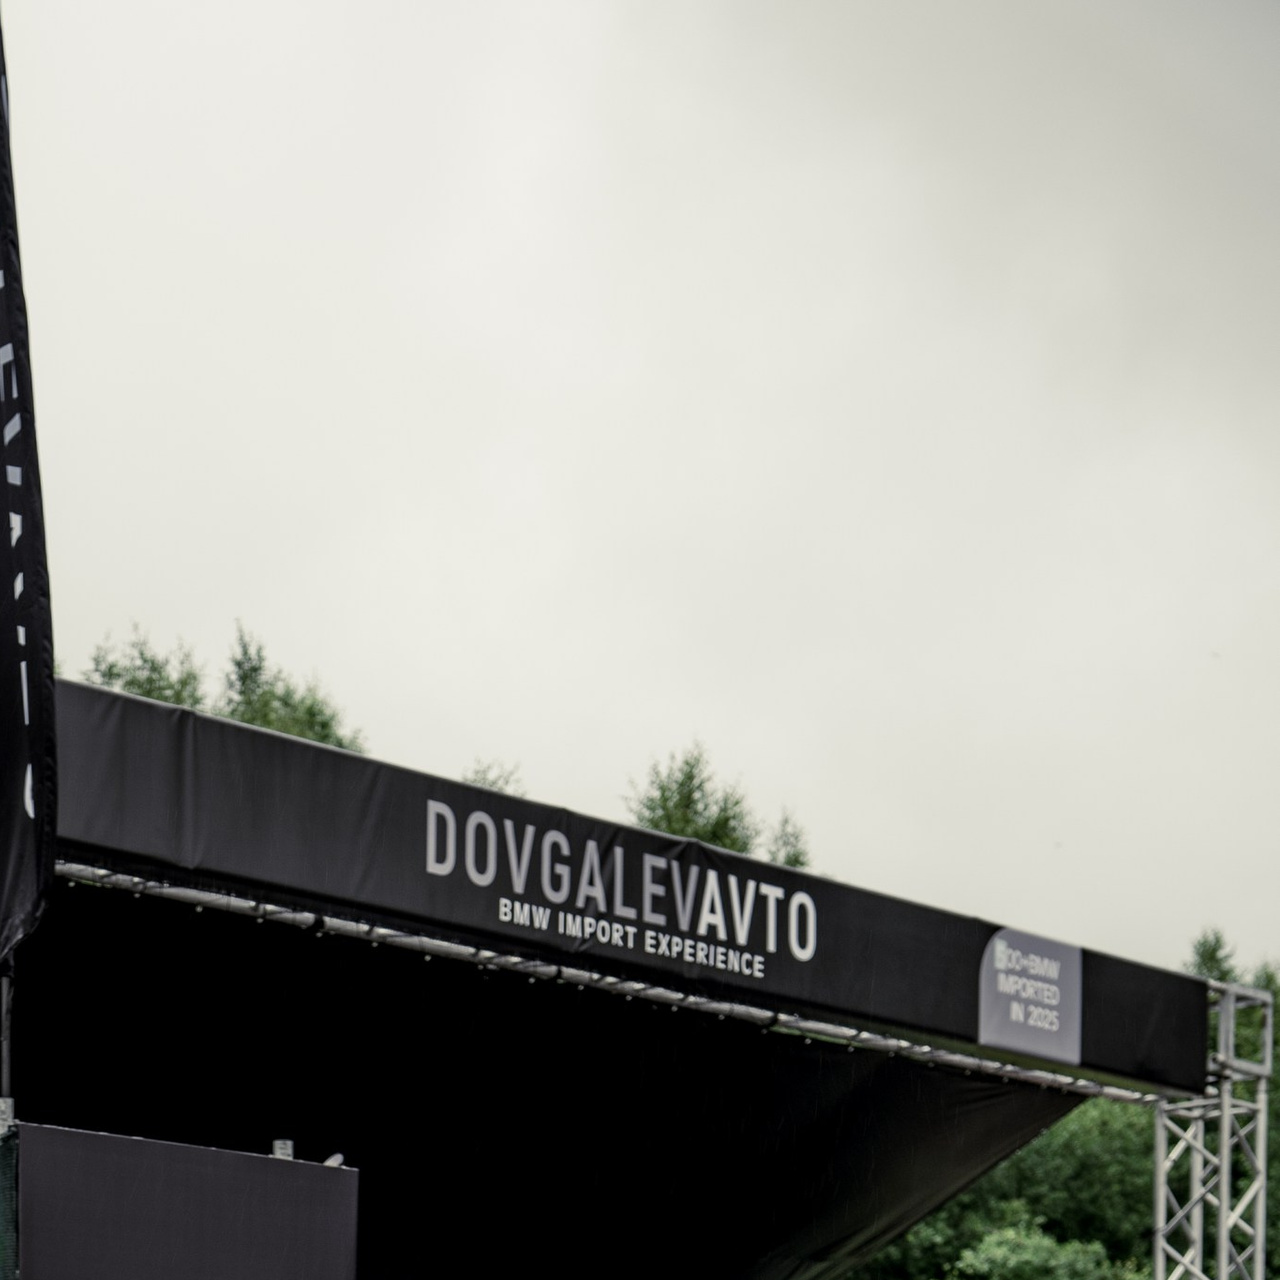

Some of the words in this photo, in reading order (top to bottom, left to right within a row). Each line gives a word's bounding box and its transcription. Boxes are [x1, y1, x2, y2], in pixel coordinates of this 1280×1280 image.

[425, 799, 818, 962] DOVGALEVAVTO
[498, 897, 551, 930] BMW
[558, 911, 638, 949] IMPORT
[644, 929, 765, 979] EXPERIENCE
[996, 972, 1061, 1006] IMPORTED
[1009, 1000, 1025, 1023] IN
